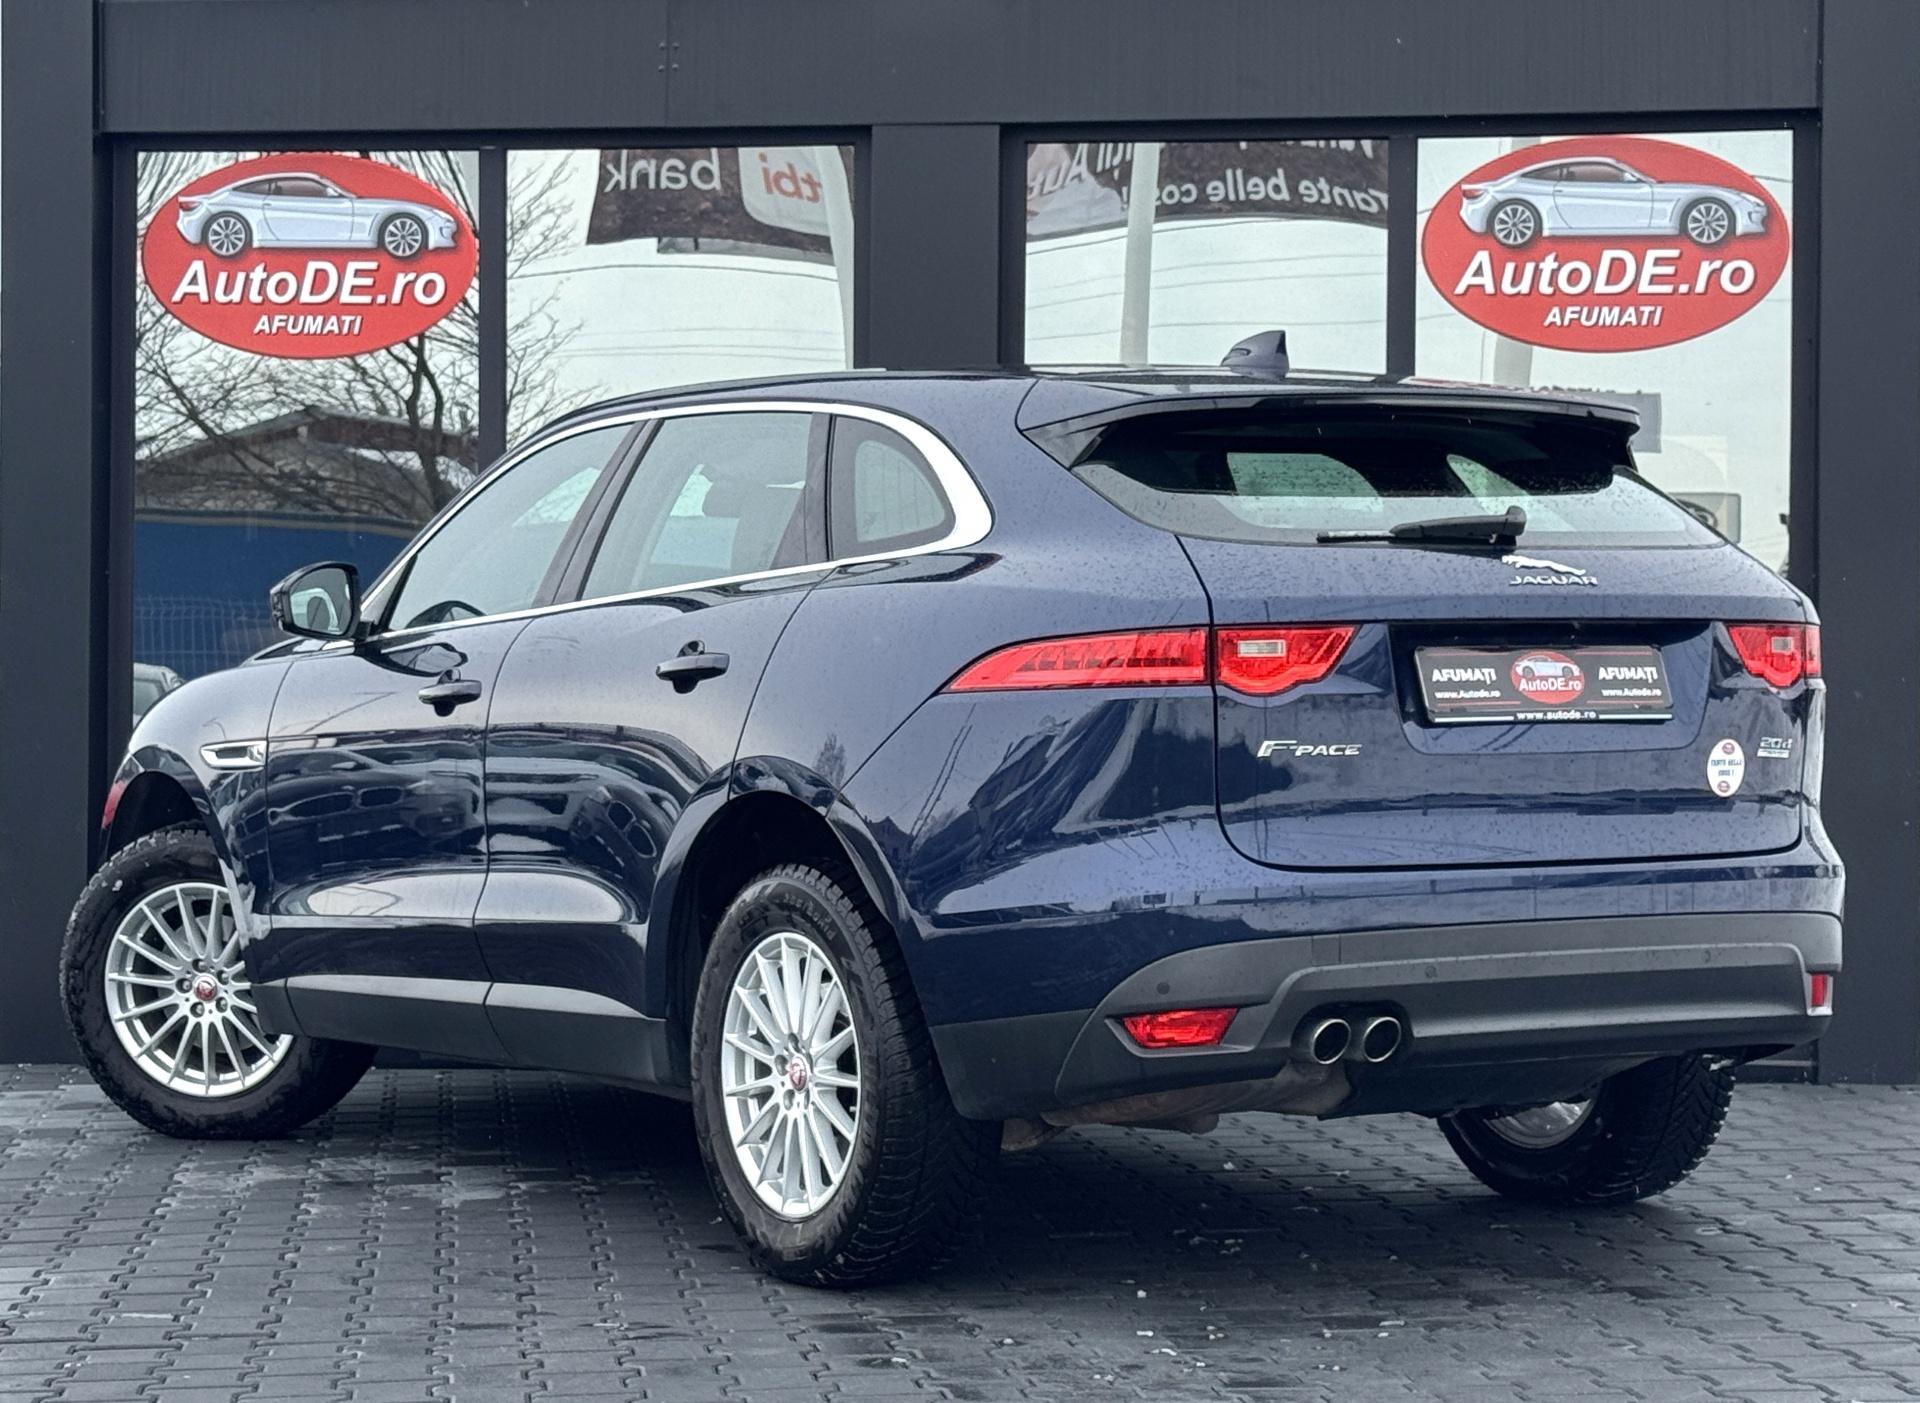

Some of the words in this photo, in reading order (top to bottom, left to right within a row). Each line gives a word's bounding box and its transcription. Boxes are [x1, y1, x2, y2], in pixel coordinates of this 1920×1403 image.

[171, 259, 447, 306] AutoDE.ro
[1454, 248, 1757, 297] AutoDE.ro
[253, 315, 364, 336] AFUMATI
[1544, 305, 1664, 327] AFUMATI
[1509, 575, 1599, 586] JAGUAR
[1519, 677, 1582, 692] AutoDE.ro
[1257, 740, 1362, 758] F-PACE
